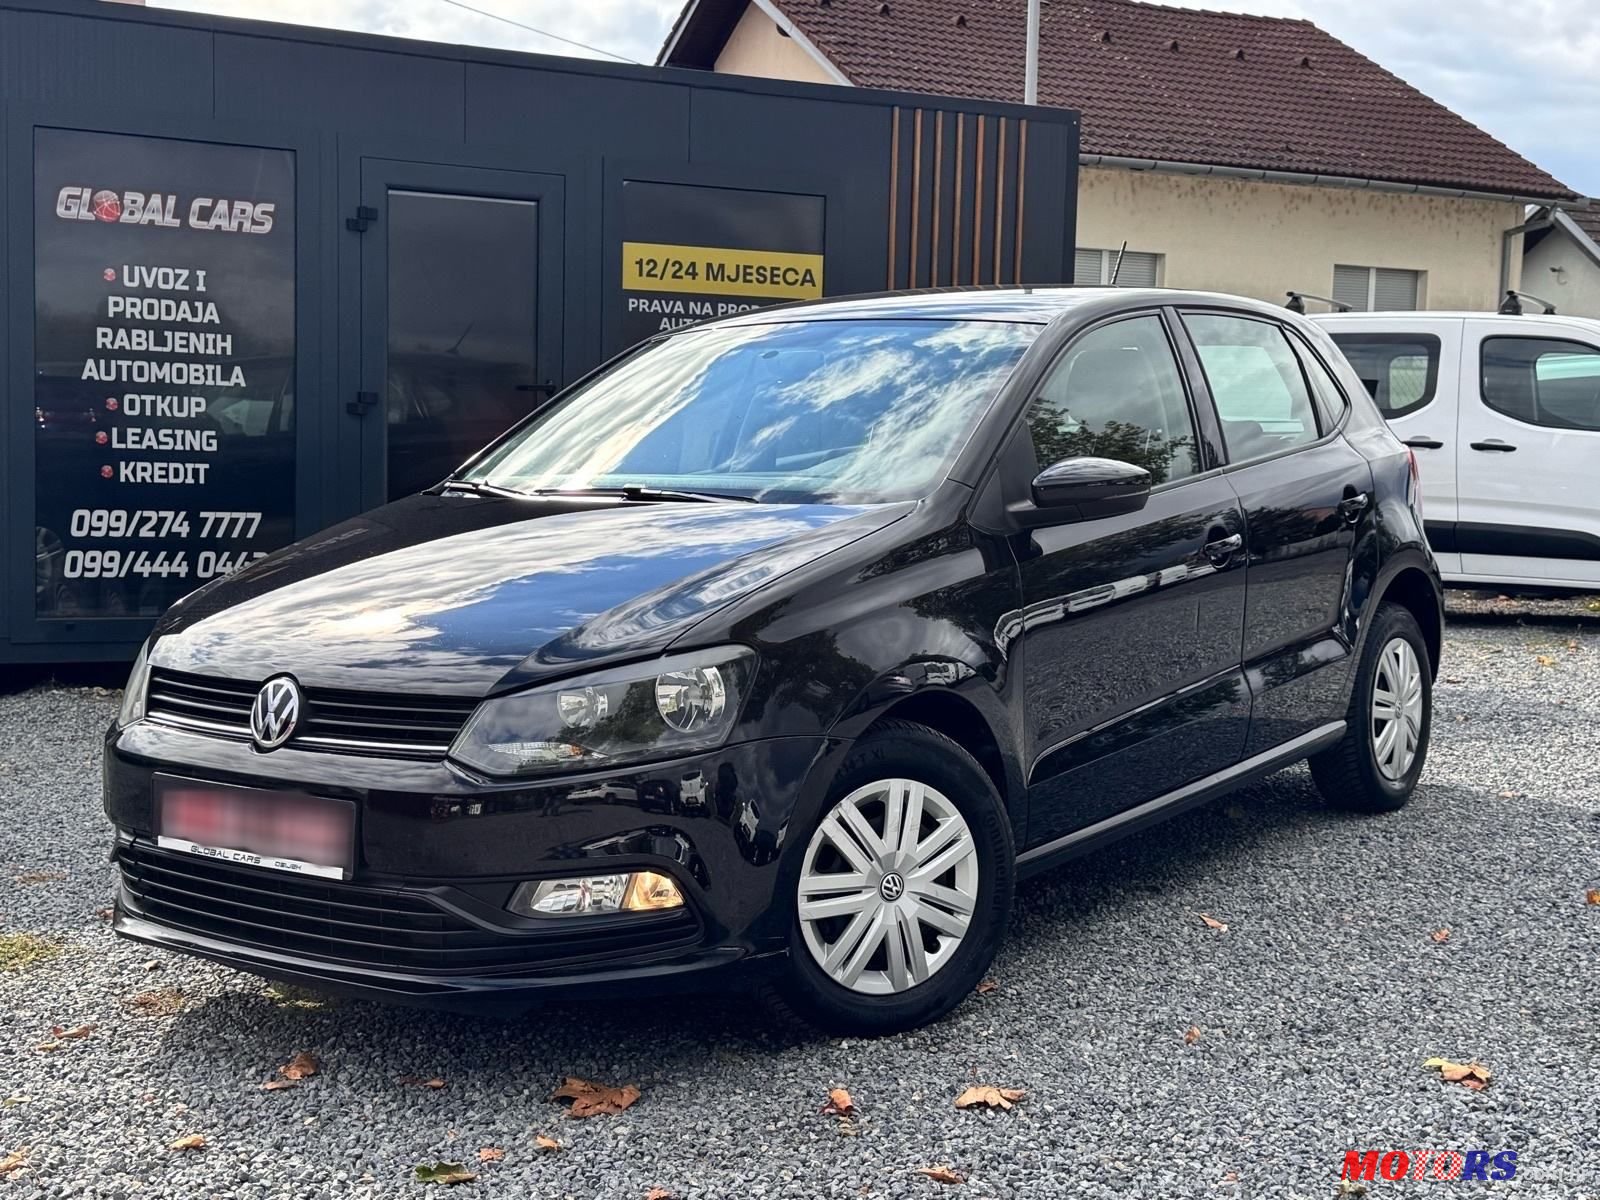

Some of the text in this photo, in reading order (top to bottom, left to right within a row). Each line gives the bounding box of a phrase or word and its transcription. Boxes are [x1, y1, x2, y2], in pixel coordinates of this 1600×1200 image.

[56, 186, 275, 234] GLOBAL CARS
[123, 265, 206, 292] UVOZ I
[634, 258, 817, 287] 12/24 MJESECA
[107, 296, 220, 324] PRODAJA
[628, 298, 685, 315] PRAVA
[689, 301, 714, 316] NA
[96, 327, 232, 356] RABLJENIH
[81, 358, 246, 387] AUTOMOBILA
[123, 394, 207, 418] OTKUP
[111, 427, 218, 451] LEASING
[119, 461, 209, 484] KREDIT
[70, 509, 262, 539] 099/274 7777
[63, 550, 188, 579] 099/444
[190, 845, 262, 865] GLOBAL CARS
